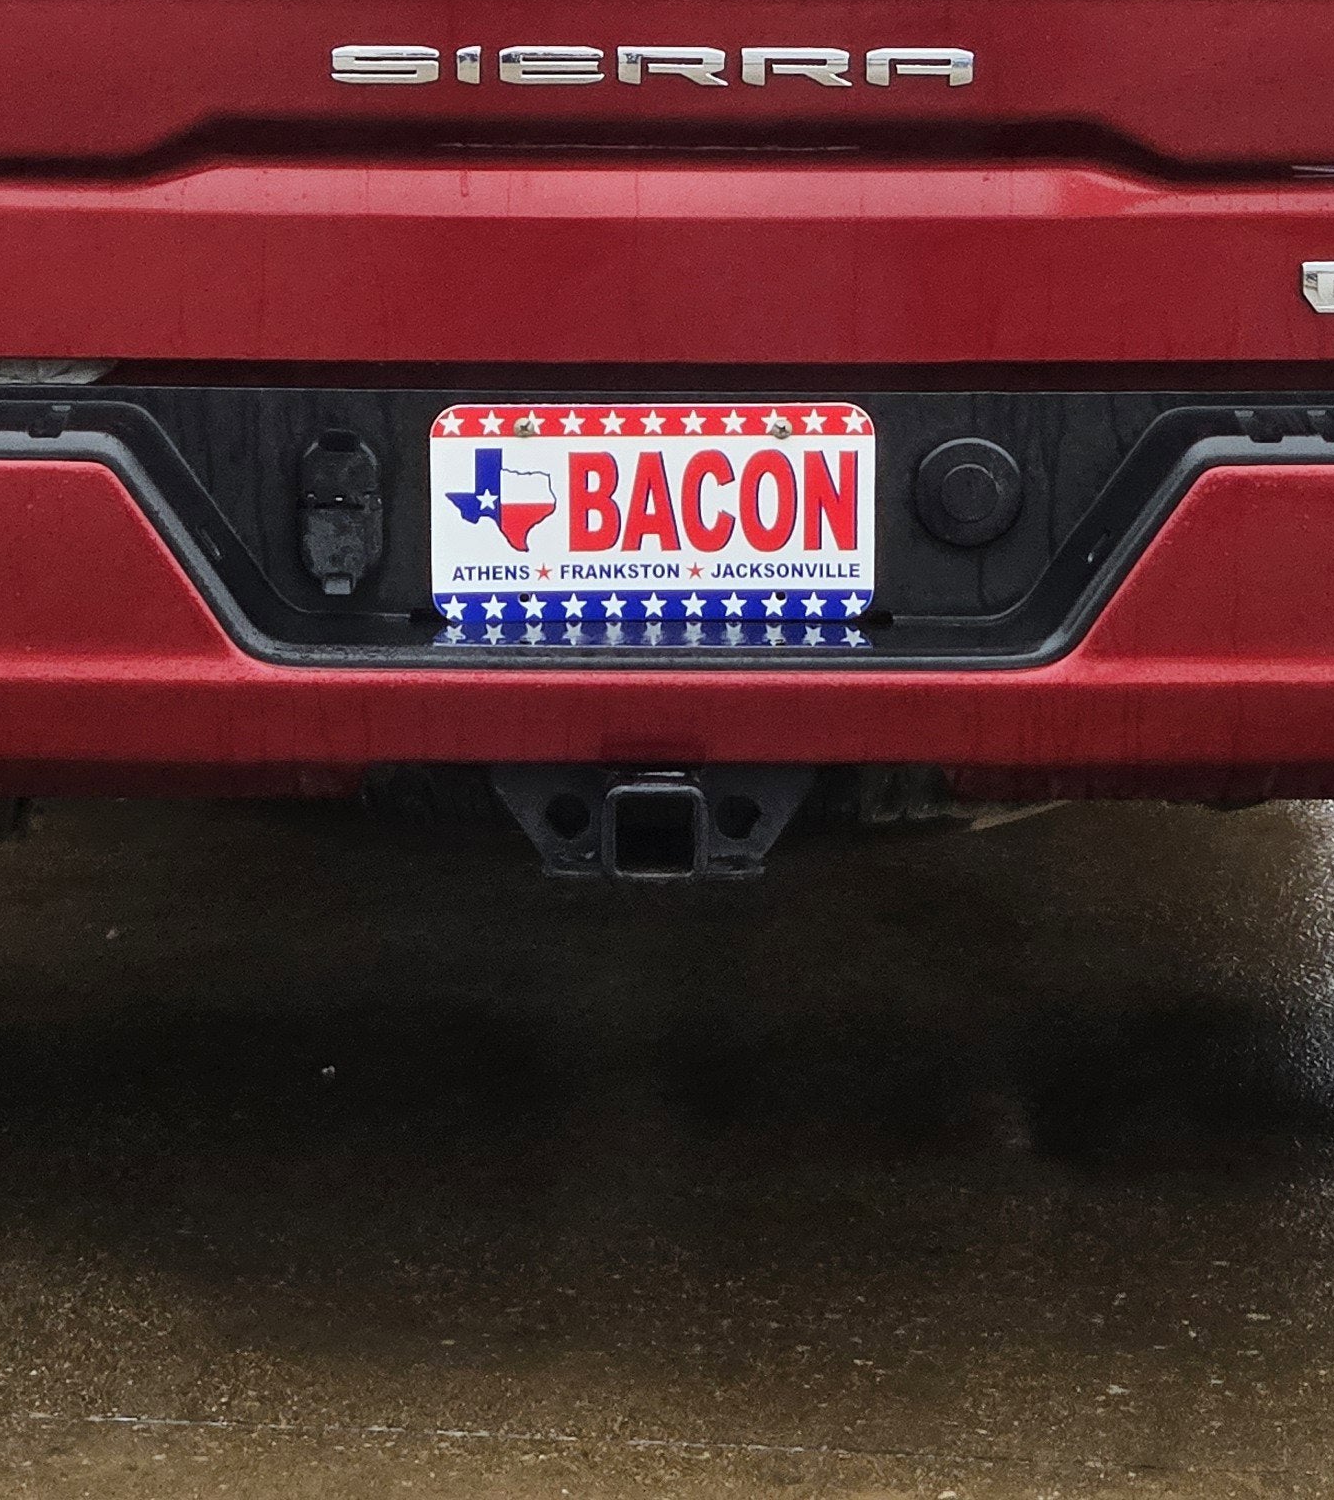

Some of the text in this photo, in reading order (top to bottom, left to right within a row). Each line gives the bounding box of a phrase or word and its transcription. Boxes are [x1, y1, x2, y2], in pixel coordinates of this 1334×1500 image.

[330, 44, 975, 88] SIERRA
[567, 448, 859, 553] BACON
[452, 562, 862, 582] ATHENS FRANKSTON JACKSONVILLE
